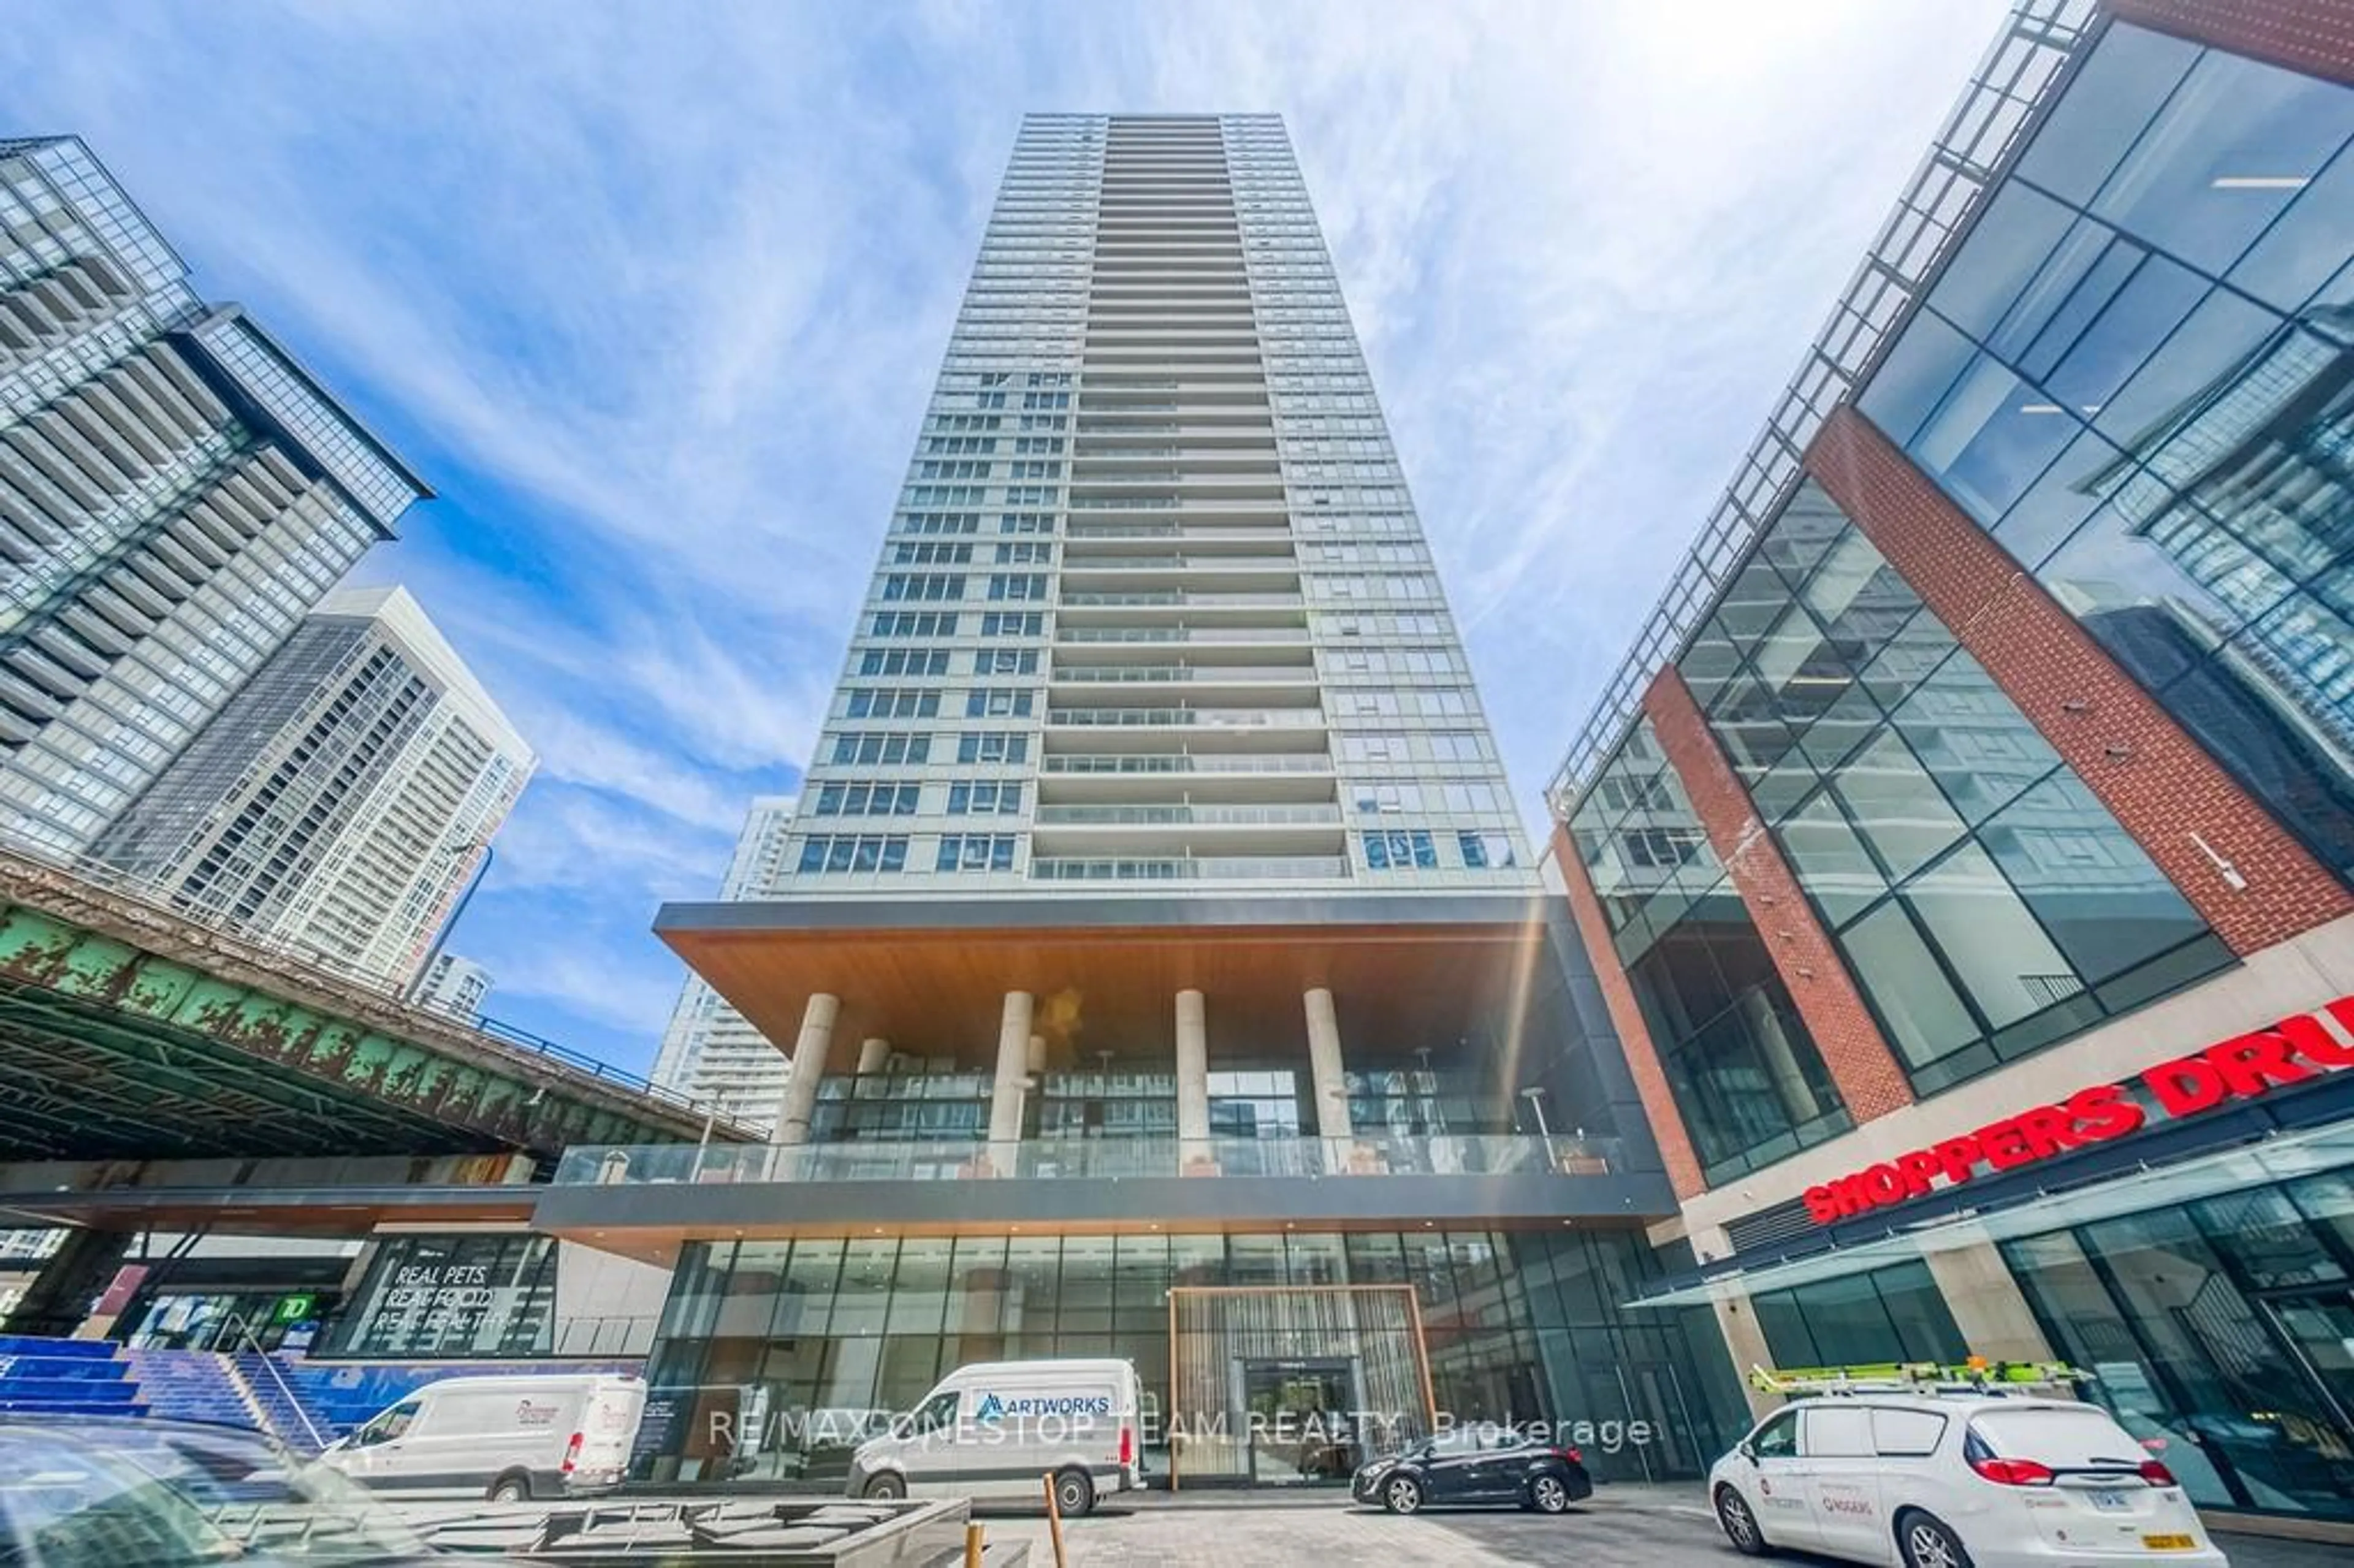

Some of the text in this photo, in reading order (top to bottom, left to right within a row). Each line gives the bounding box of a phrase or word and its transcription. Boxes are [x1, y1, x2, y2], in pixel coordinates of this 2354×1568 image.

[1802, 993, 2354, 1225] SHOPPERS DRU
[395, 1266, 440, 1284] REAL
[282, 1298, 307, 1319] TD
[1007, 1397, 1110, 1415] ARTWORKS
